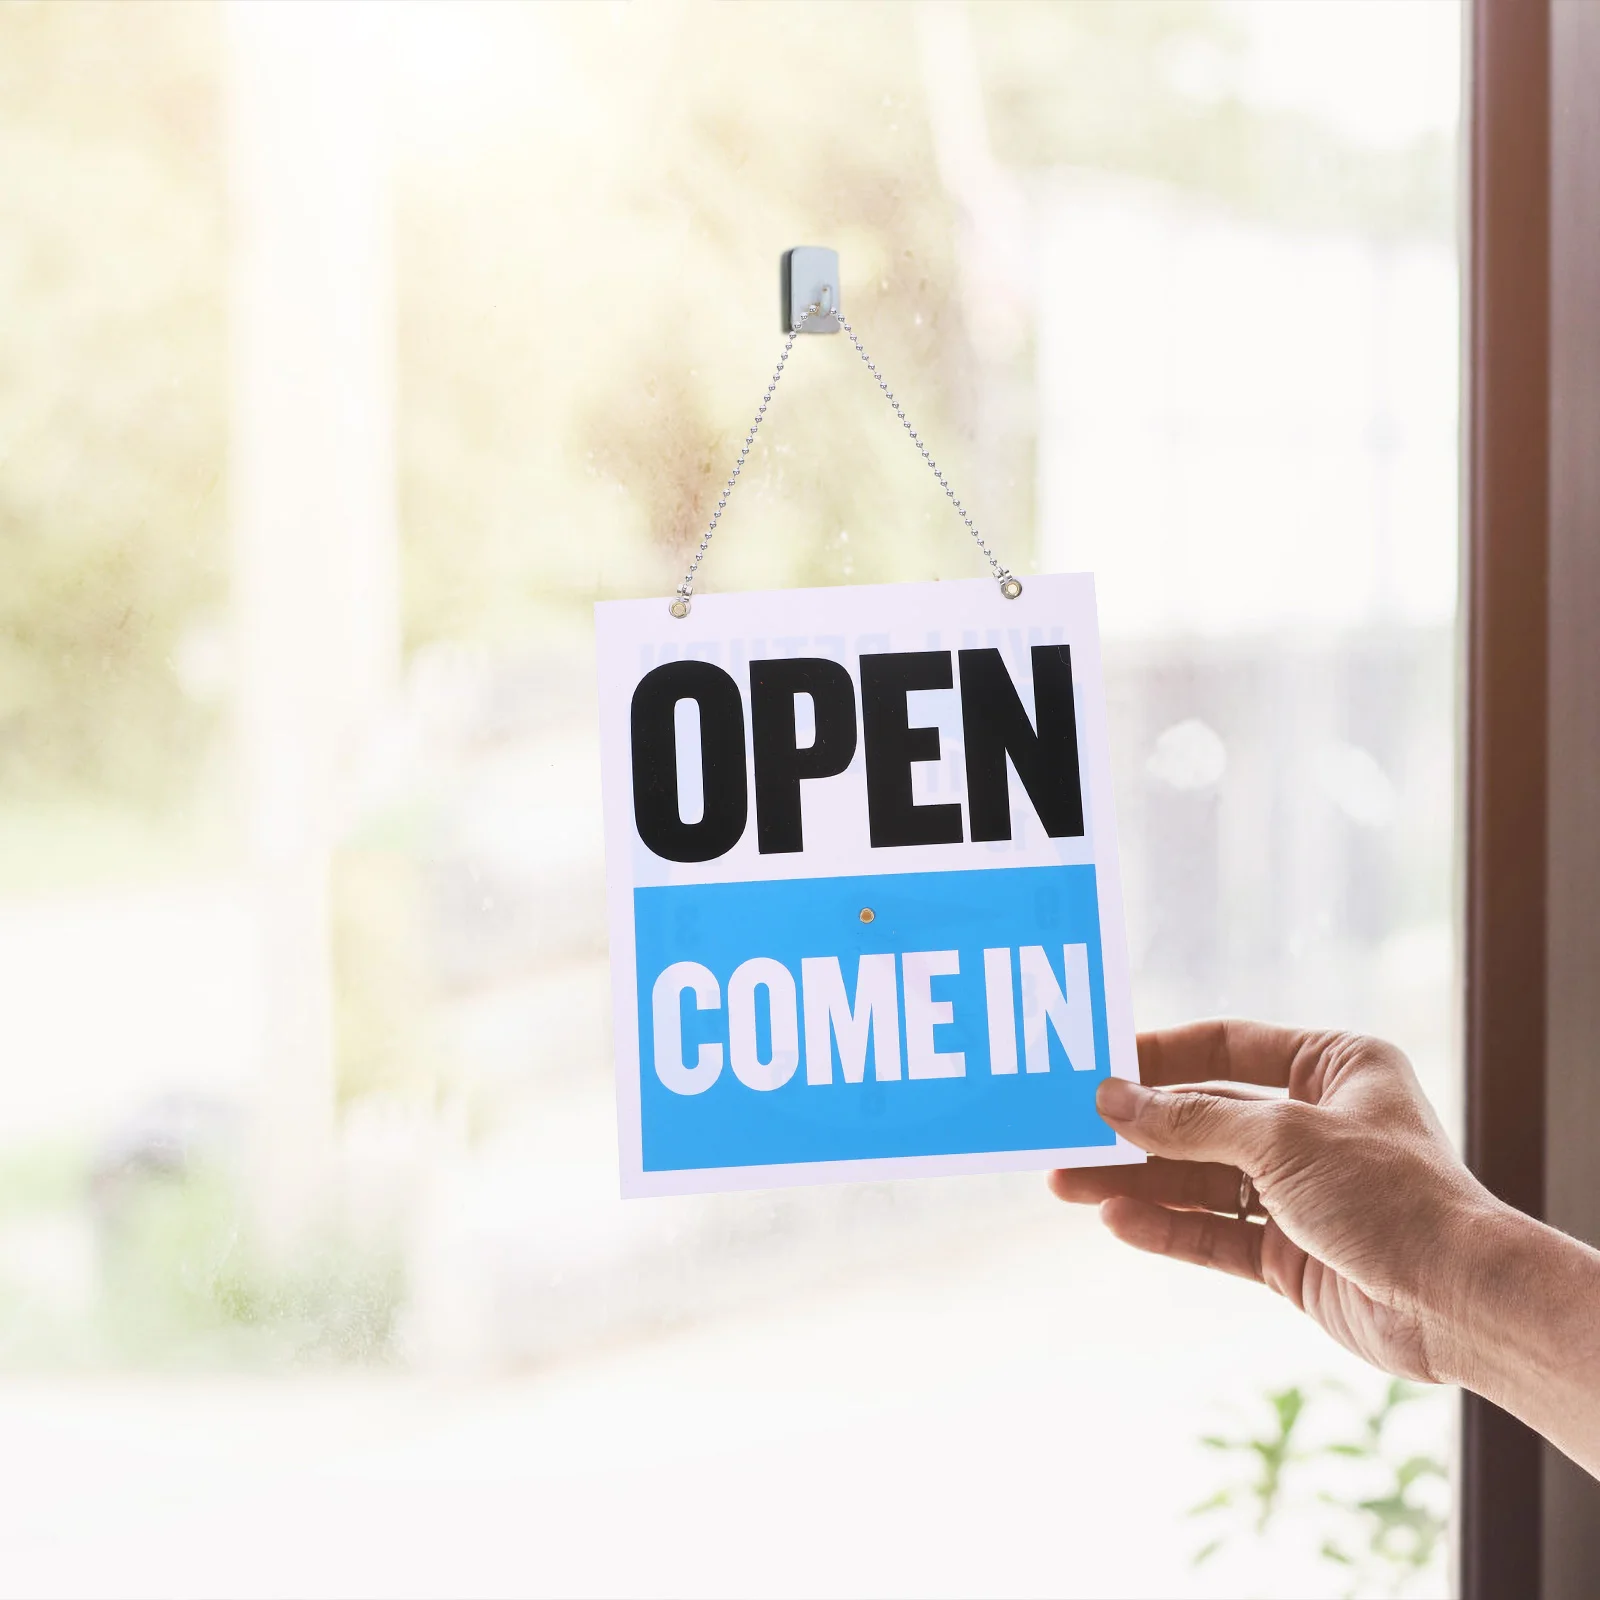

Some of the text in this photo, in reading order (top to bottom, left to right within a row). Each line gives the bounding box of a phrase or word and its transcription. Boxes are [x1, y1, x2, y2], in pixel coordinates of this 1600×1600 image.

[631, 645, 1084, 862] OPEN
[652, 943, 1096, 1095] COME IN
